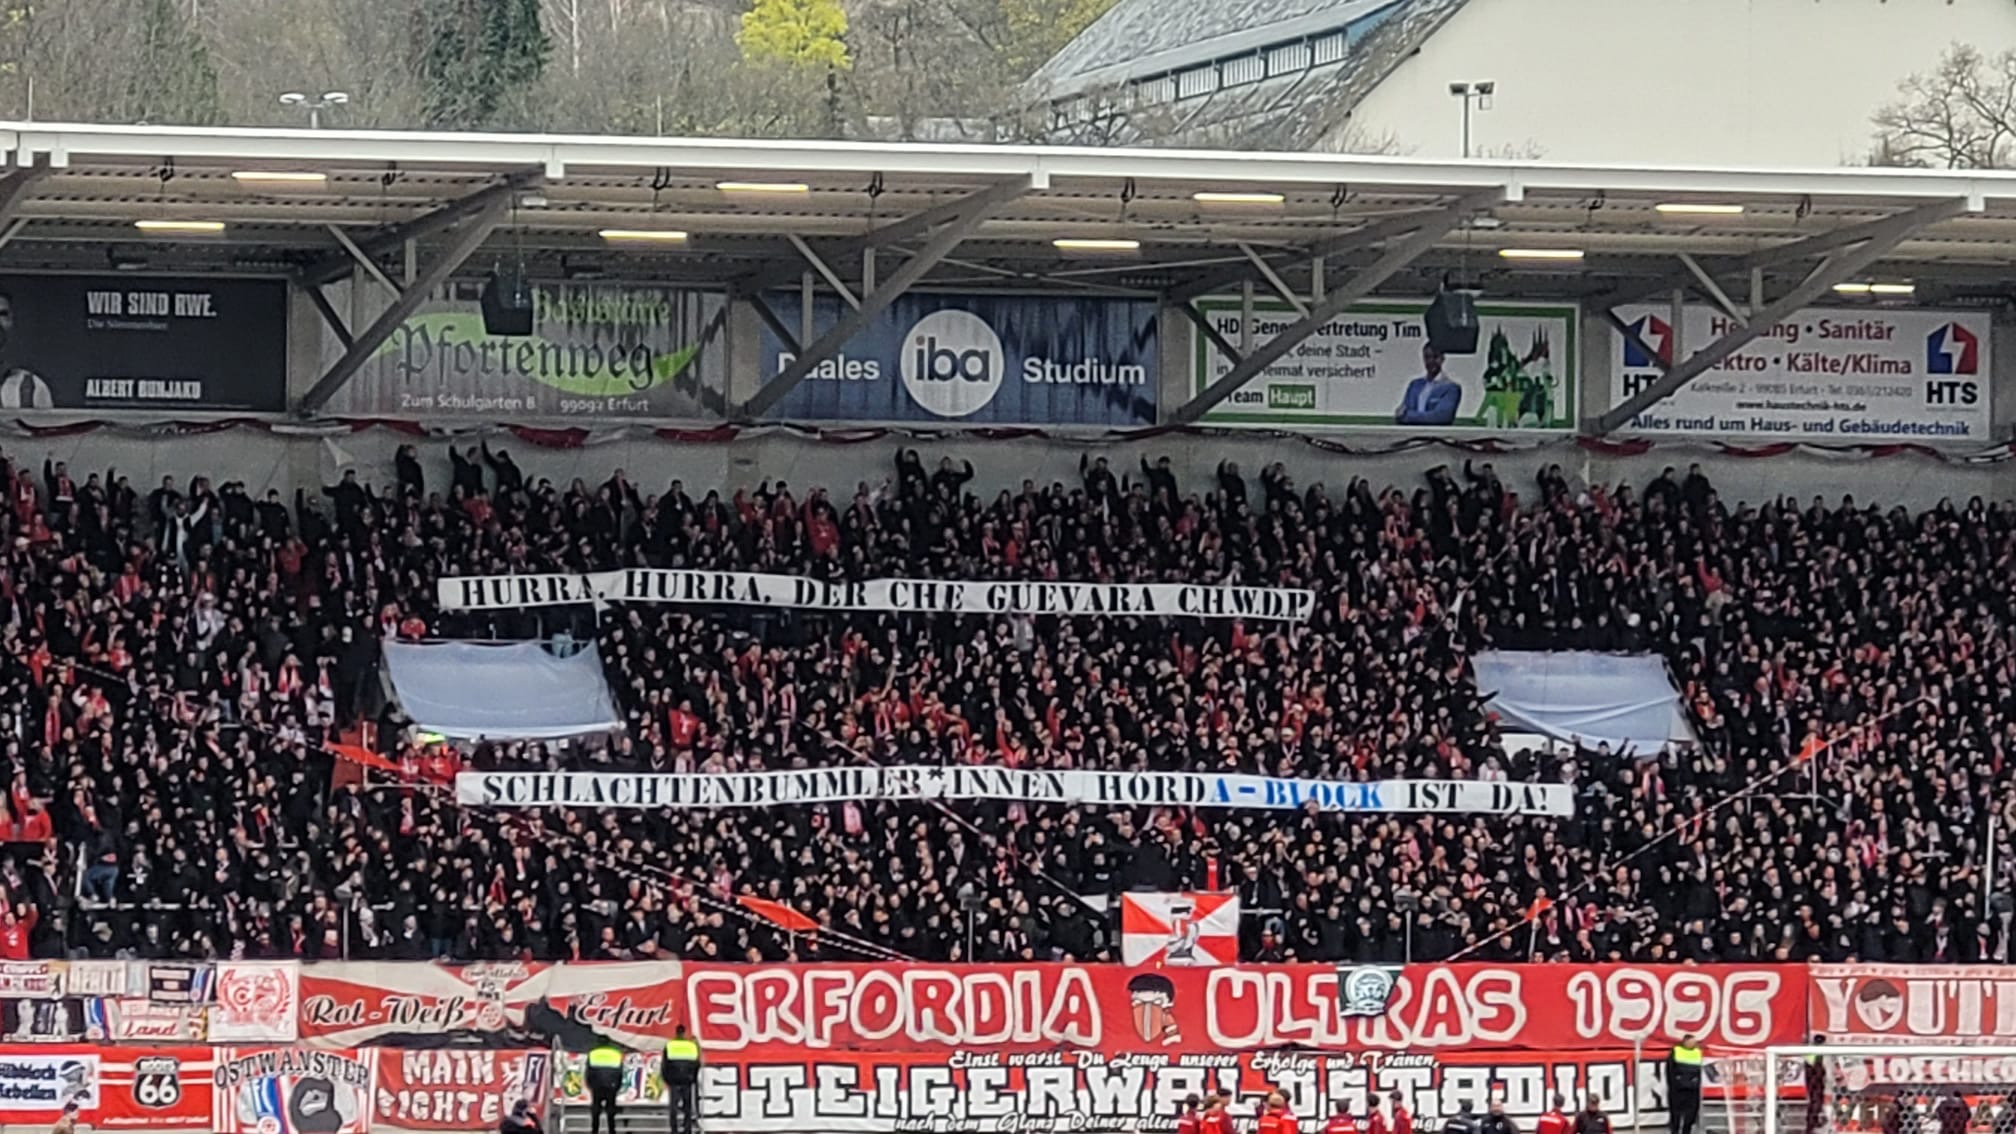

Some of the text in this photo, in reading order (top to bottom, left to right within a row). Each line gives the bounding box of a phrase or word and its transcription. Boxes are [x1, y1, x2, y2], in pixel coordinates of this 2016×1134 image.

[87, 291, 122, 315] WIR
[128, 292, 169, 315] SIND
[1393, 321, 1421, 337] Tim
[1818, 319, 1896, 342] Sanitär
[392, 321, 654, 391] Pfortenweg
[915, 335, 990, 383] iba
[1023, 357, 1146, 385] Studium
[1297, 344, 1331, 358] deine
[1336, 344, 1371, 358] Stadt
[1306, 366, 1376, 379] versichert!
[1787, 352, 1912, 376] Kälte/Klima
[402, 394, 434, 408] Zum
[438, 394, 522, 411] Schulgarten
[608, 398, 649, 412] Erfurt
[1927, 381, 1979, 405] HTS
[1631, 414, 1970, 436] Alles rund um Haus- und Gebäudetechnik
[794, 578, 868, 607] DER
[889, 580, 965, 611] CHE
[987, 582, 1156, 612] GUEVARA
[1406, 782, 1464, 809] IST
[1491, 784, 1548, 812] DA!
[576, 993, 672, 1028] Erfurt
[687, 968, 1780, 1049] ERFORDIA ULTRAS 1996
[403, 1050, 496, 1086] MAIN
[949, 1050, 999, 1068] Einst
[1009, 1052, 1062, 1067] warst
[1071, 1051, 1104, 1069] Du
[1180, 1054, 1237, 1068] unserer
[1251, 1052, 1317, 1076] Erfolge
[1326, 1053, 1354, 1069] und
[139, 1075, 177, 1104] 66
[896, 1113, 935, 1131] nach
